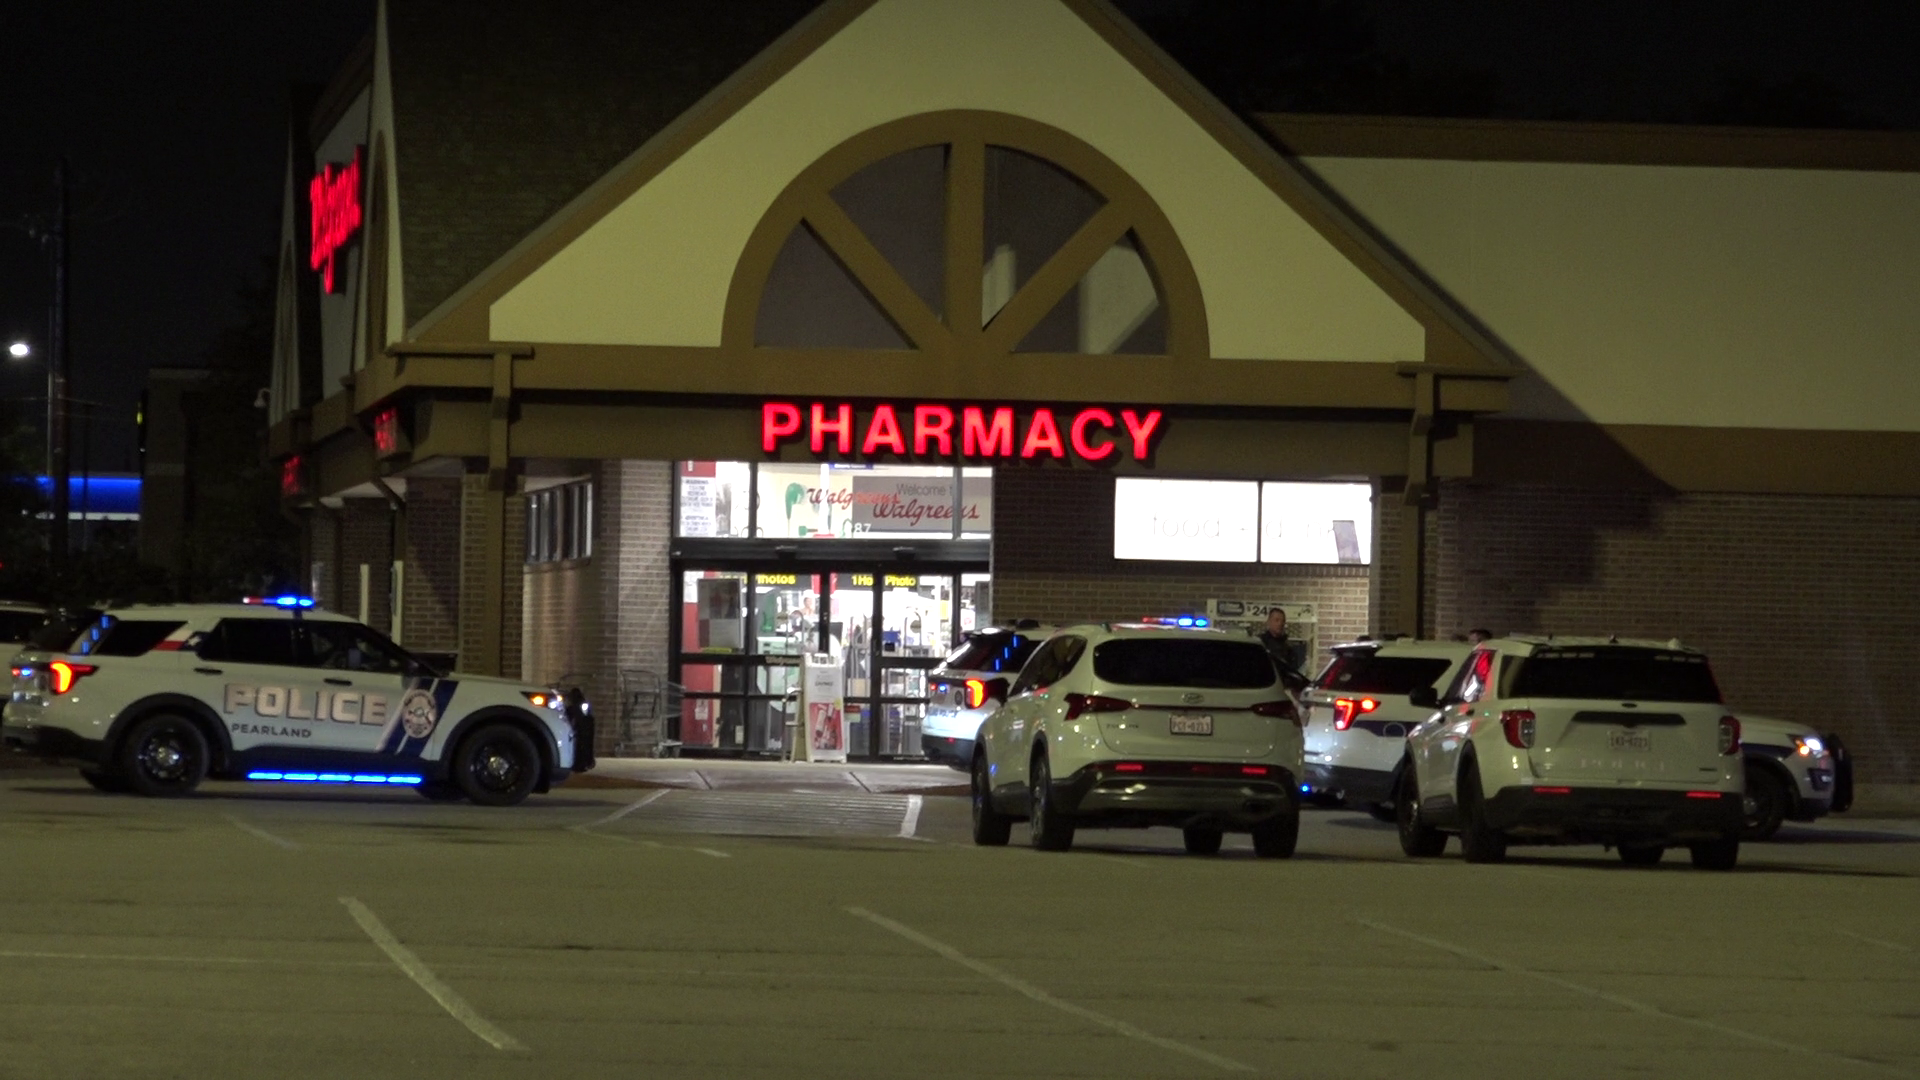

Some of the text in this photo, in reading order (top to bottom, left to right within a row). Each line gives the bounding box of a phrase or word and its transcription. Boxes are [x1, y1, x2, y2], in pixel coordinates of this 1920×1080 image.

[762, 402, 1161, 460] PHARMACY
[897, 483, 945, 496] Welcome
[873, 499, 980, 527] Walgrees
[756, 574, 796, 585] hotos
[884, 574, 917, 587] Photo
[224, 683, 387, 727] POLICE
[231, 723, 312, 738] PEARLAND
